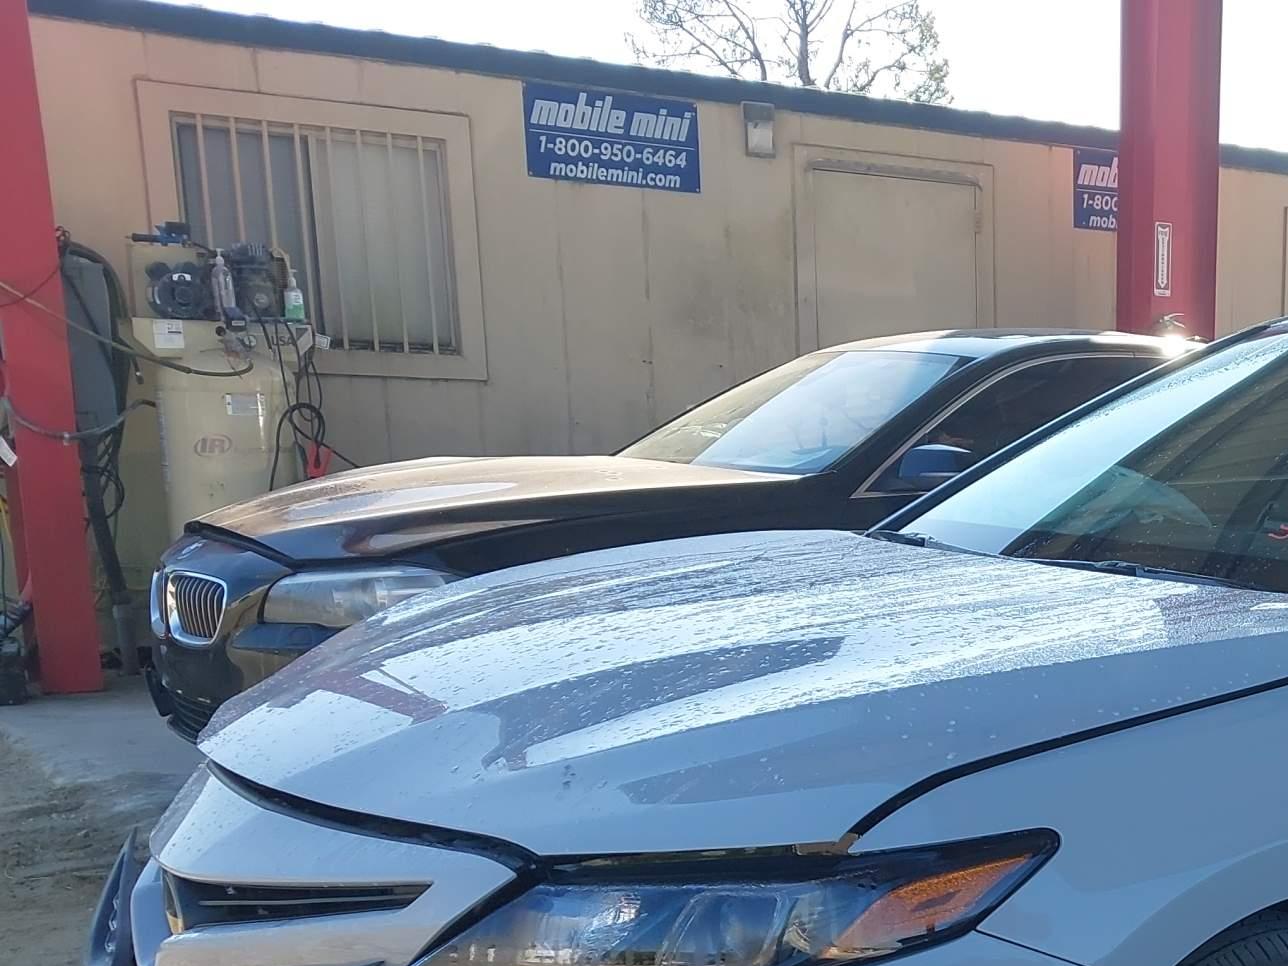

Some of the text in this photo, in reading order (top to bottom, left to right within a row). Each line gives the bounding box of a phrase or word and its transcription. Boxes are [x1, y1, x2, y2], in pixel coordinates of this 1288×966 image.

[530, 92, 692, 142] mobile mini
[539, 135, 687, 169] 1-800-950-6464
[550, 161, 681, 188] mobilemini.com
[1089, 214, 1118, 229] mob
